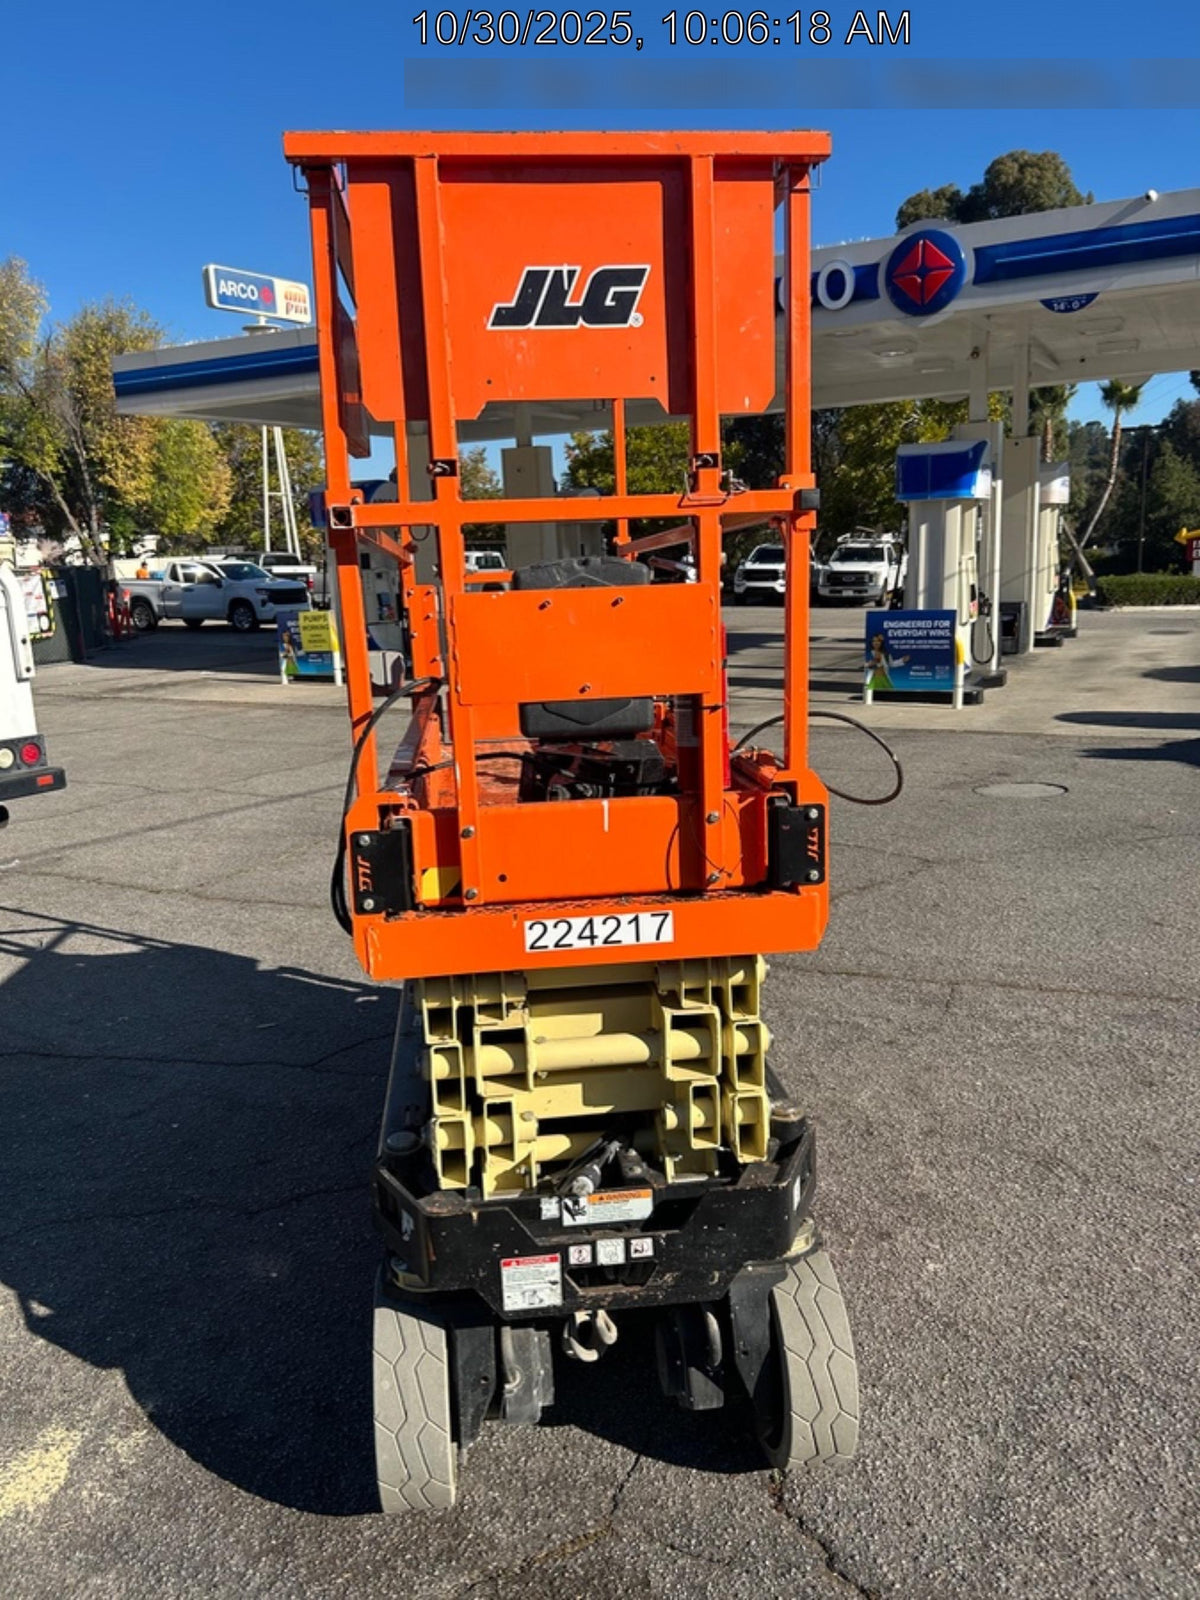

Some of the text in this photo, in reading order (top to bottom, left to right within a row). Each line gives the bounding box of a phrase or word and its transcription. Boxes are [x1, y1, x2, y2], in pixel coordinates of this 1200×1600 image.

[219, 279, 258, 300] ARCO
[487, 264, 651, 330] JLG
[883, 620, 950, 629] ENGINEERED FOR
[888, 629, 927, 637] EVERYDAY
[528, 912, 670, 950] 224217
